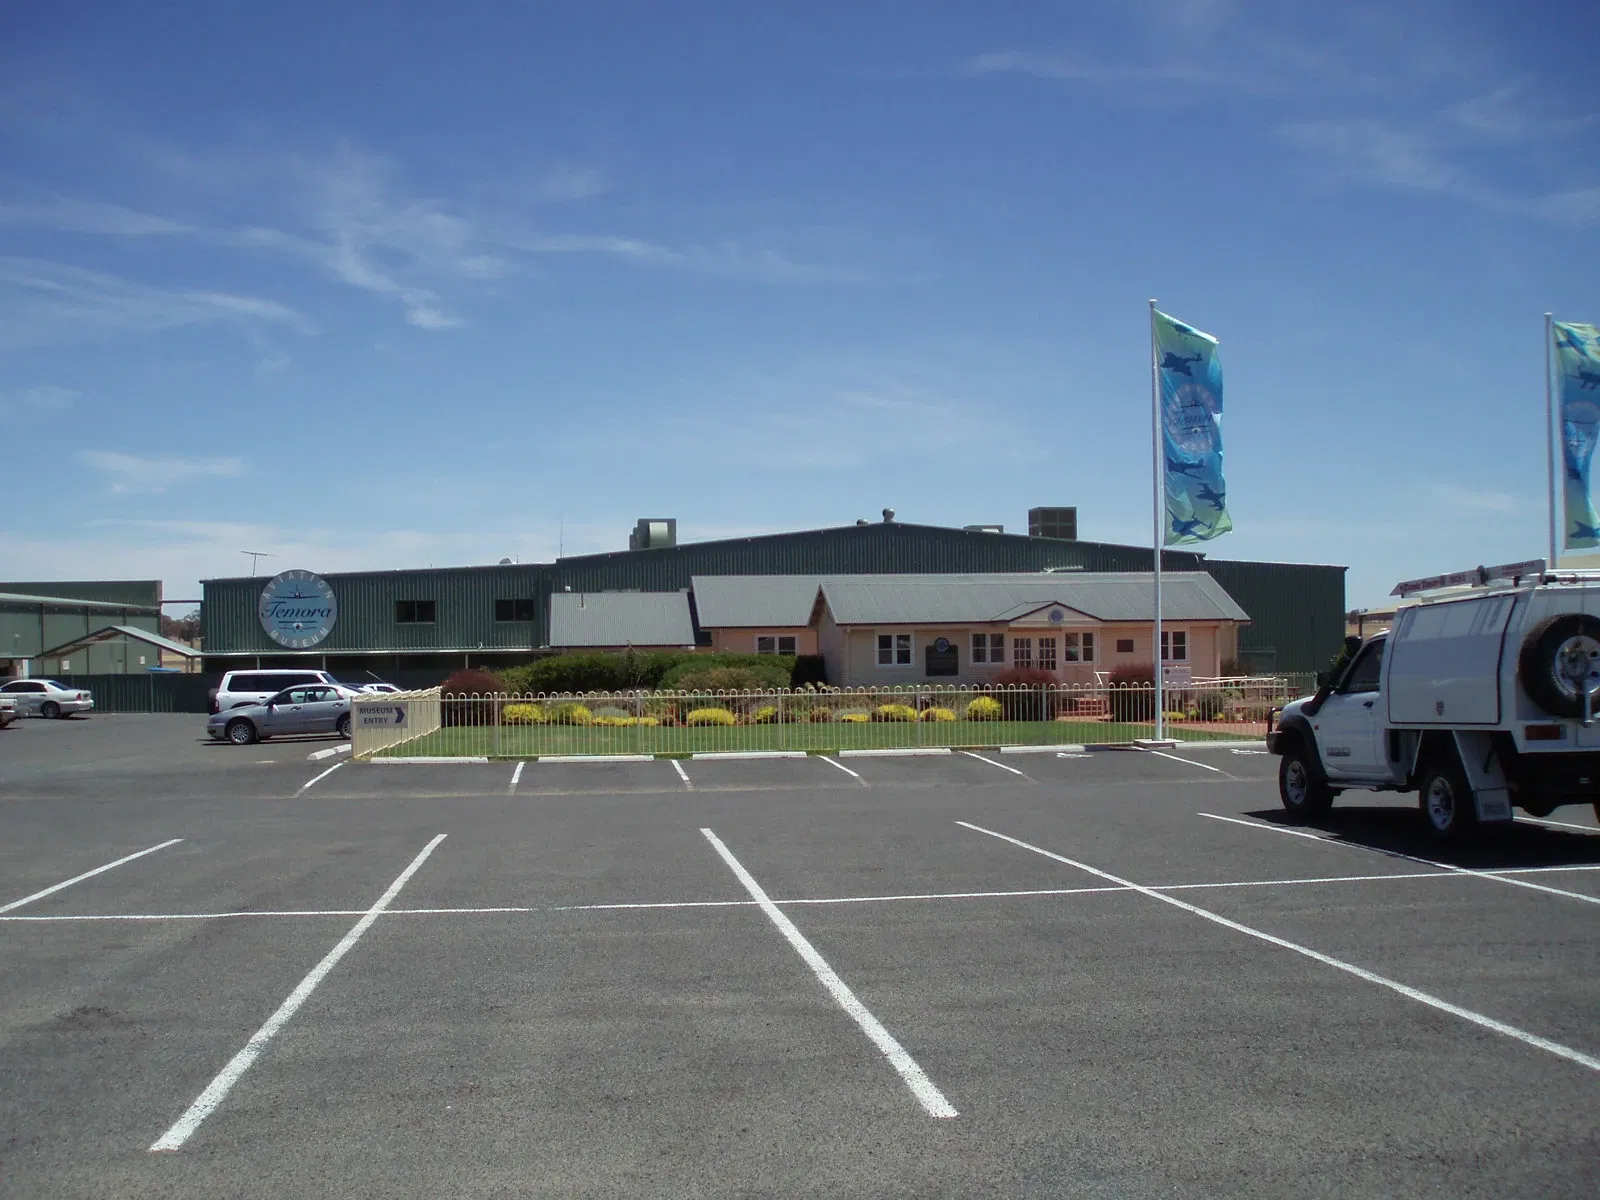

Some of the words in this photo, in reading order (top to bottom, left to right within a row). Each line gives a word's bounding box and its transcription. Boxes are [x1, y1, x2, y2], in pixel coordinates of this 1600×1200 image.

[261, 571, 334, 600] AVIATION
[261, 601, 333, 619] Temora
[270, 627, 329, 648] MUSEUM
[359, 707, 393, 715] MUSEUM
[363, 717, 389, 725] ENTRY
